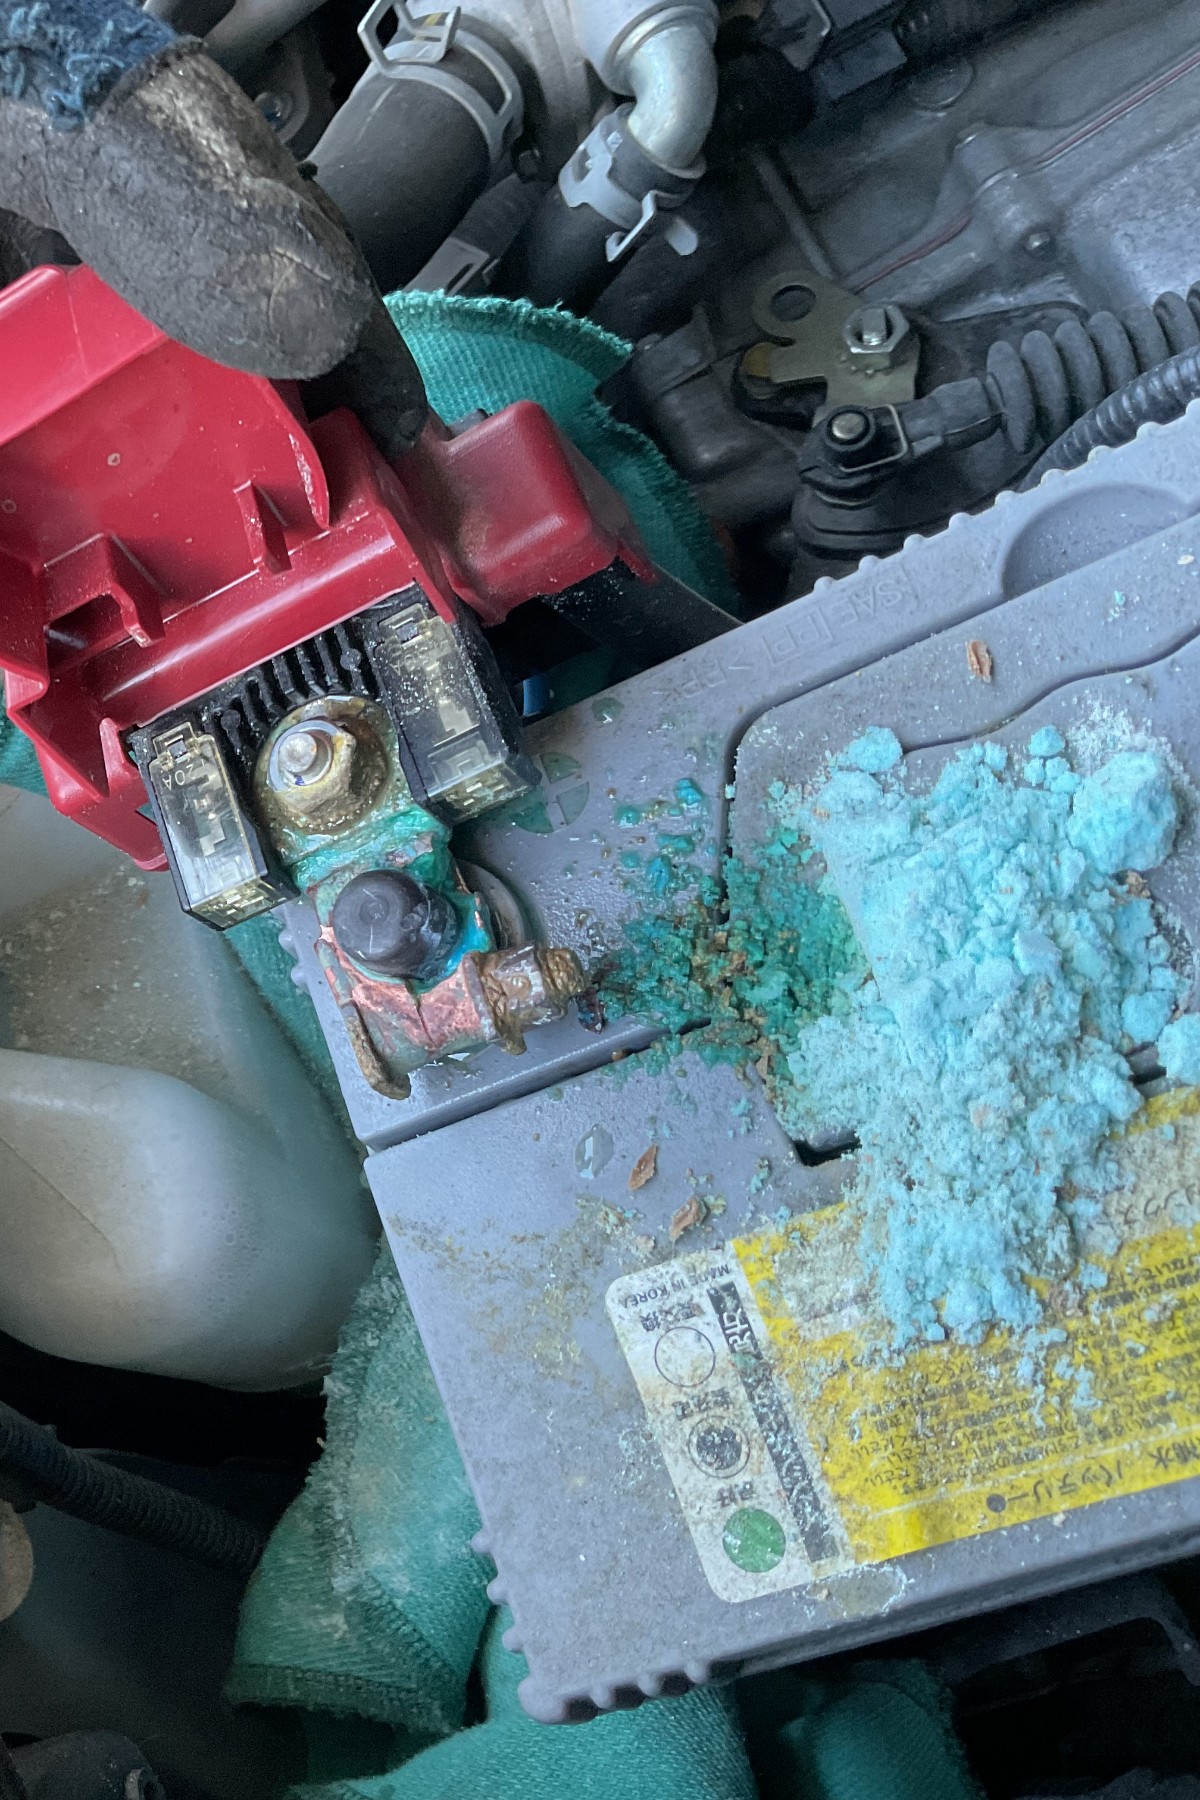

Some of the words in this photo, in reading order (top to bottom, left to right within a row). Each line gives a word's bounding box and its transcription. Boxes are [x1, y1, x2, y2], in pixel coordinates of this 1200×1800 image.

[689, 1263, 728, 1284] MADE
[670, 1278, 685, 1291] IN
[619, 1284, 667, 1308] KOREA
